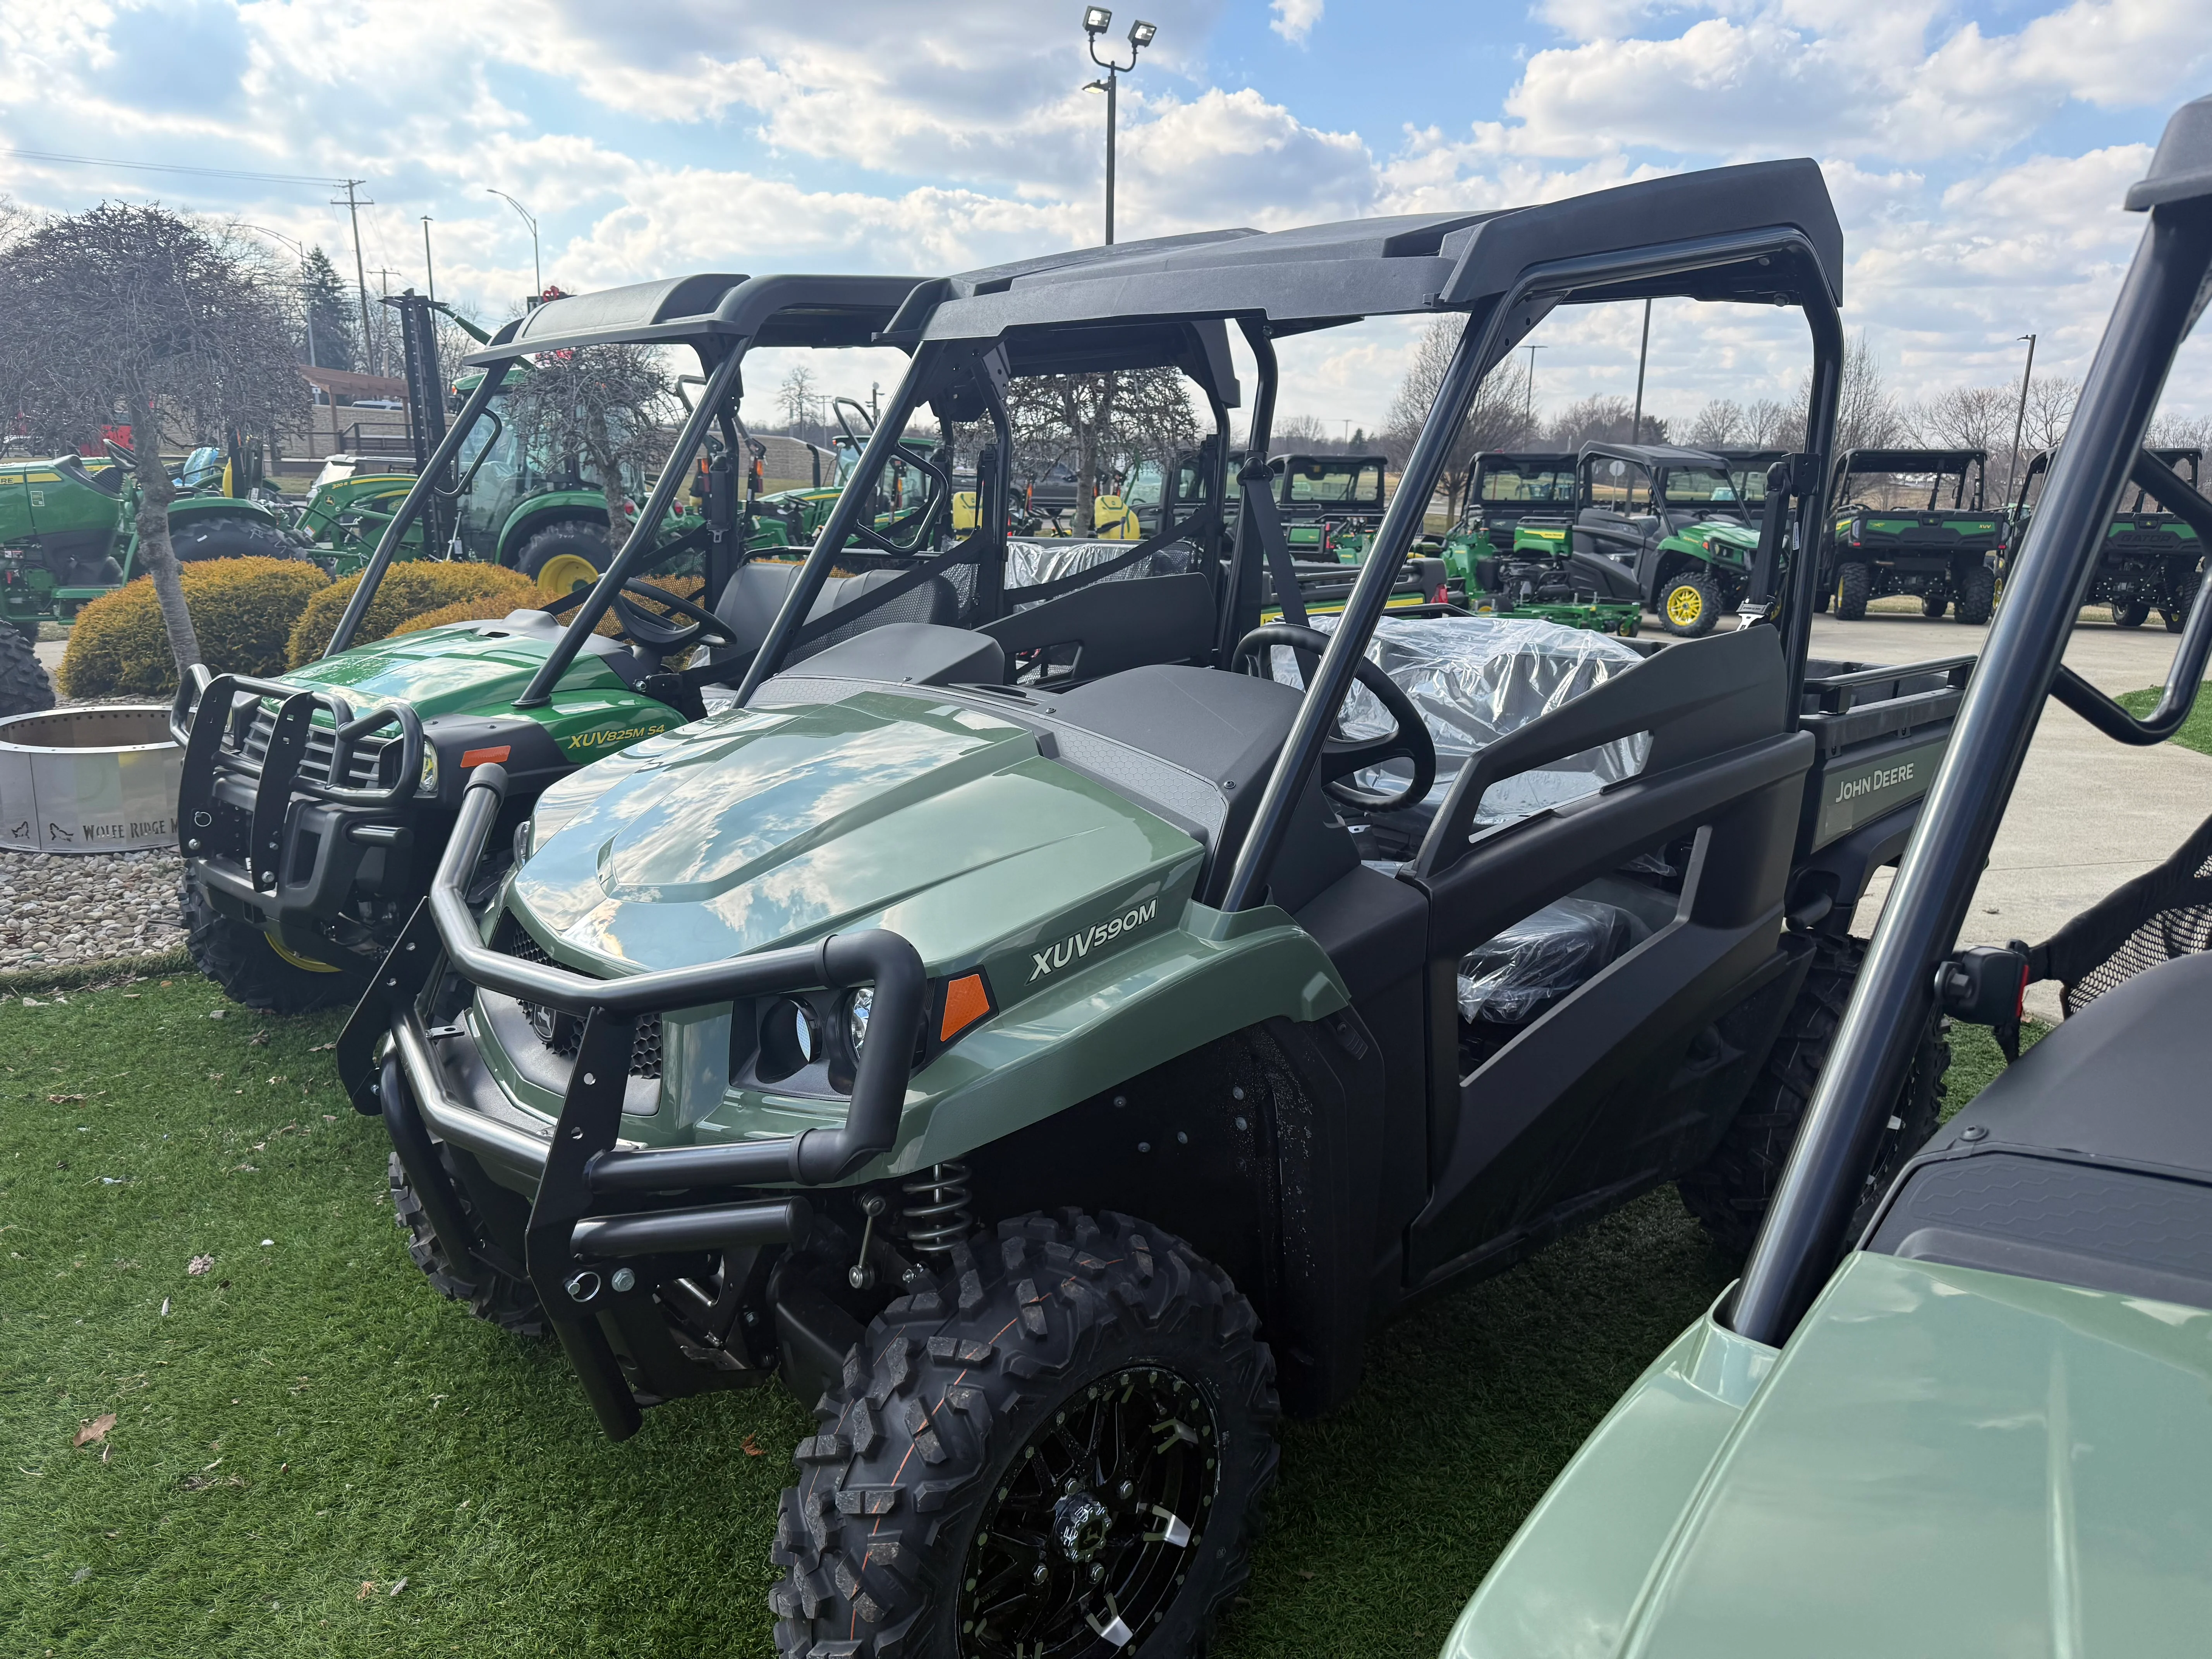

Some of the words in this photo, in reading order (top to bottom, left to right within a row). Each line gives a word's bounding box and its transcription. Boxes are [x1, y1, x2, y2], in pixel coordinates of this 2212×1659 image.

[568, 727, 645, 749] XUV825M
[647, 724, 665, 735] S4
[1835, 776, 1871, 803] JOHN
[1873, 763, 1914, 790] DEERE
[130, 820, 166, 838] RIDGE
[170, 818, 178, 833] M
[1029, 899, 1156, 982] XUV590M
